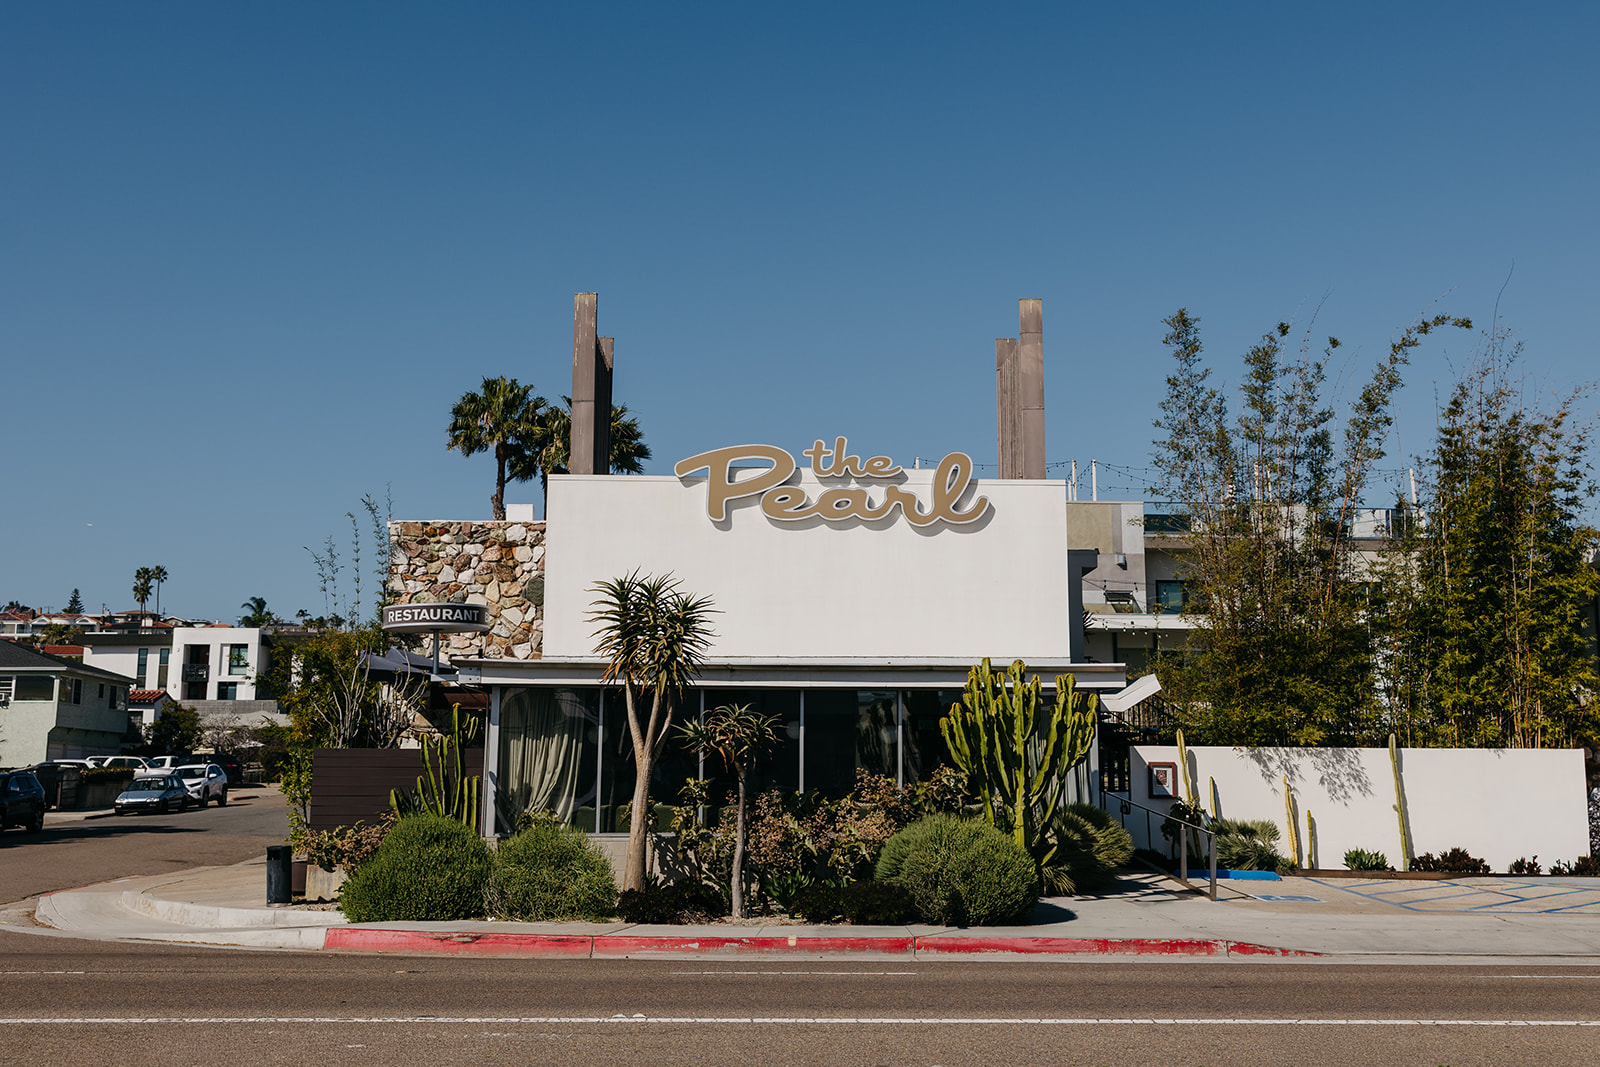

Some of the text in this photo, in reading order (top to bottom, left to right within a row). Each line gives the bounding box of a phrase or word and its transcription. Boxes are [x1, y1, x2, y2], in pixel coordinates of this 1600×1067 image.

[802, 436, 902, 478] the
[674, 444, 989, 527] Pearl
[388, 608, 480, 622] RESTAURANT
